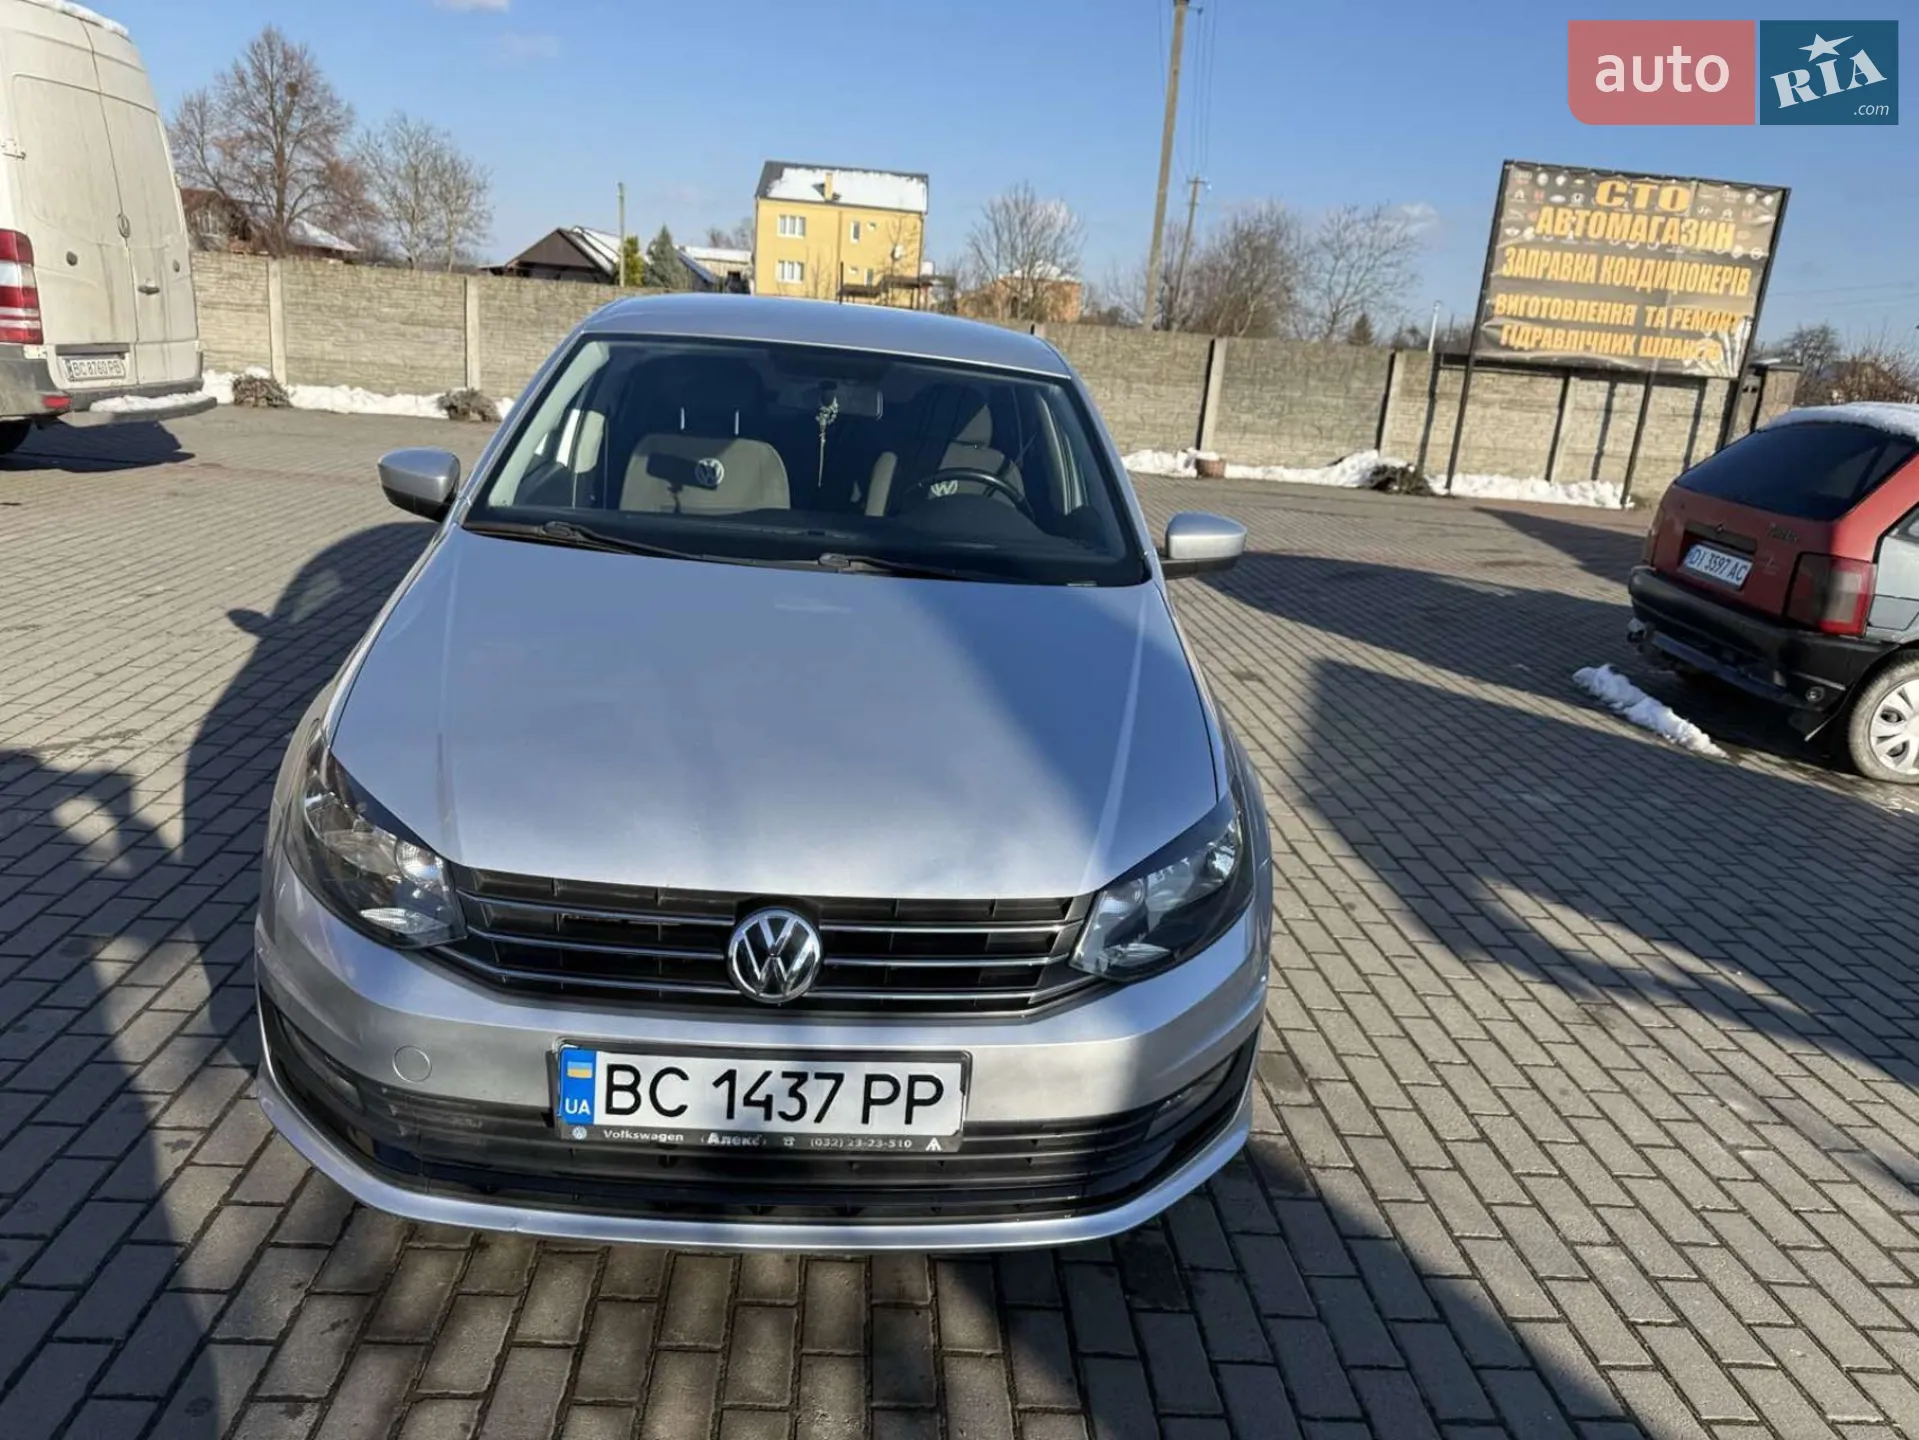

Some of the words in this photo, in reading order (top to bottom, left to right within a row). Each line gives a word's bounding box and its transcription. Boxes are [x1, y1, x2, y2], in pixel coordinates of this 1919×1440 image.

[1595, 179, 1691, 212] СТО
[1535, 206, 1736, 251] АВТОМАГАЗИН
[1502, 246, 1598, 284] ЗАПРАВКА
[1599, 255, 1752, 296] КОНДИЦІОНЕРІВ
[1495, 293, 1638, 326] ВИГОТОВЛЕННЯ
[1645, 305, 1668, 328] ТА
[1501, 323, 1638, 356] ГІДРАВЛІЧНИХ
[1726, 561, 1748, 581] AC
[564, 1098, 591, 1116] UA
[605, 1063, 690, 1117] BC
[711, 1068, 845, 1124] 1437
[861, 1073, 945, 1126] PP
[603, 1129, 684, 1142] Volkswagen
[810, 1138, 844, 1149] (032)
